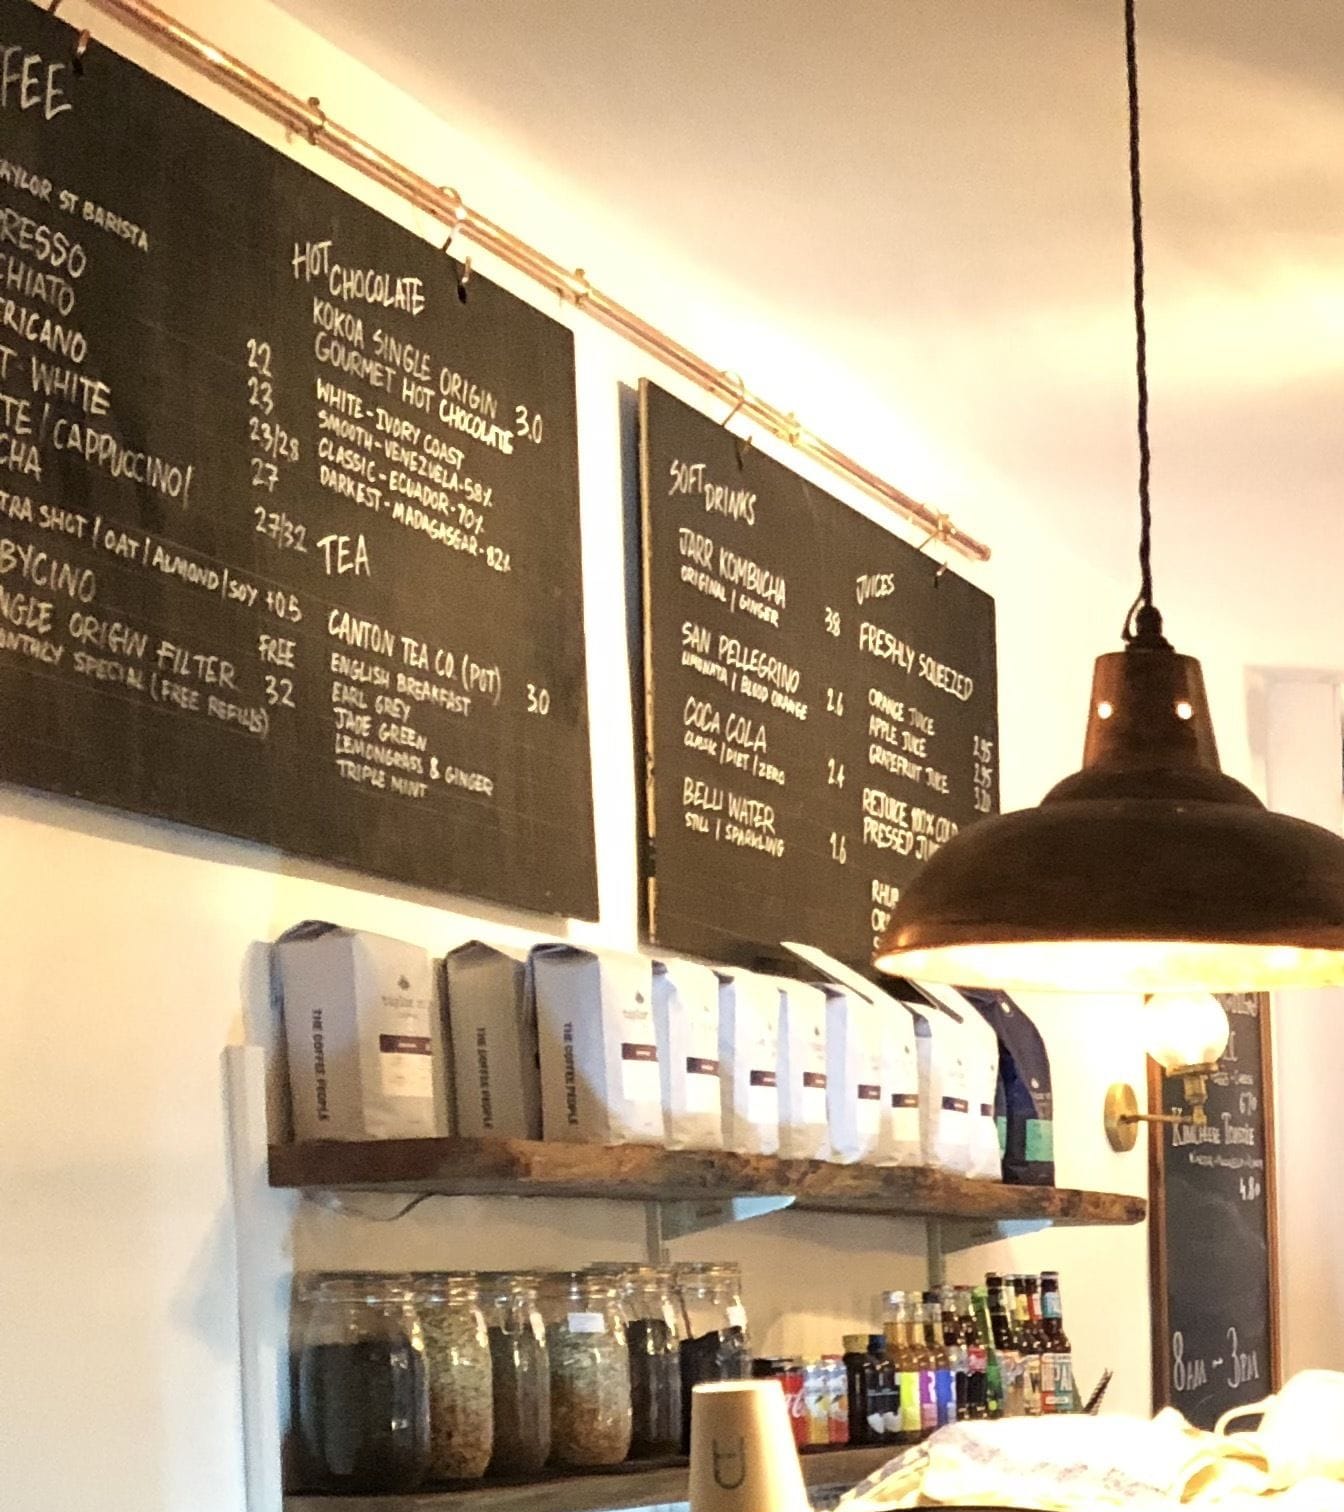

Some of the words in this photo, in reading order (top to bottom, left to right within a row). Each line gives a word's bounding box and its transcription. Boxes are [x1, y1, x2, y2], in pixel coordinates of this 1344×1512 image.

[0, 45, 72, 120] FEE
[59, 189, 79, 214] ST
[0, 207, 87, 278] RESSO
[291, 240, 333, 282] HOT
[329, 263, 426, 316] CHOCOLATE
[0, 296, 87, 364] RICANO
[313, 296, 365, 350] KOKOA
[373, 329, 431, 382] SINGLE
[439, 367, 498, 419] ORIGIN
[32, 356, 111, 415] WHITE
[314, 331, 396, 394] GOURMET
[402, 376, 436, 414] HOT
[438, 398, 514, 455] CHOCOLATE
[316, 377, 365, 419] WHITE
[376, 408, 420, 445] IVORY
[423, 434, 465, 470] COAST
[318, 409, 374, 452] SMOOTH
[385, 439, 459, 492] VENEZUELA
[53, 419, 182, 497] CAPPUCCINO
[318, 437, 377, 483] CLASSIC
[389, 470, 449, 516] ECUADOR
[320, 465, 383, 512] DARKEST
[668, 459, 707, 495] SOFT
[704, 483, 757, 526] DRINKS
[39, 505, 87, 538] SHOT
[105, 529, 140, 559] OAT
[152, 546, 219, 590] ALMOND
[228, 579, 258, 607] SOY
[316, 534, 371, 577] TEA
[678, 527, 713, 572] JARR
[719, 547, 786, 609] KOMBUCHA
[856, 573, 895, 605] JUICES
[69, 612, 148, 658] ORIGIN
[156, 640, 242, 693] FILTER
[258, 634, 297, 669] FREE
[328, 608, 396, 657] CANTON
[401, 636, 429, 671] TEA
[461, 654, 501, 706] (POT)
[681, 621, 711, 655] SAN
[718, 634, 800, 694] PELLEGRINO
[859, 622, 915, 674] FRESHLY
[918, 653, 973, 701] SQUEEZED
[331, 652, 390, 688] ENGLISH
[396, 673, 471, 717] BREAKFAST
[332, 681, 368, 709] EARL
[375, 695, 411, 723] GREY
[868, 688, 905, 722] ORANGE
[333, 707, 372, 737] JADE
[378, 723, 428, 752] GREEN
[683, 696, 720, 735] COCA
[725, 712, 767, 753] COLA
[869, 714, 898, 746] APPLE
[335, 733, 424, 774] LEMONGRASS
[444, 766, 494, 796] GINGER
[335, 759, 386, 789] TRIPLE
[391, 776, 428, 798] MINT
[726, 748, 750, 771] DIET
[685, 811, 709, 832] STILL
[725, 823, 784, 858] SPARKLING
[729, 792, 776, 835] WATER
[863, 817, 913, 855] PRESSED
[313, 1034, 325, 1075] COFFEE
